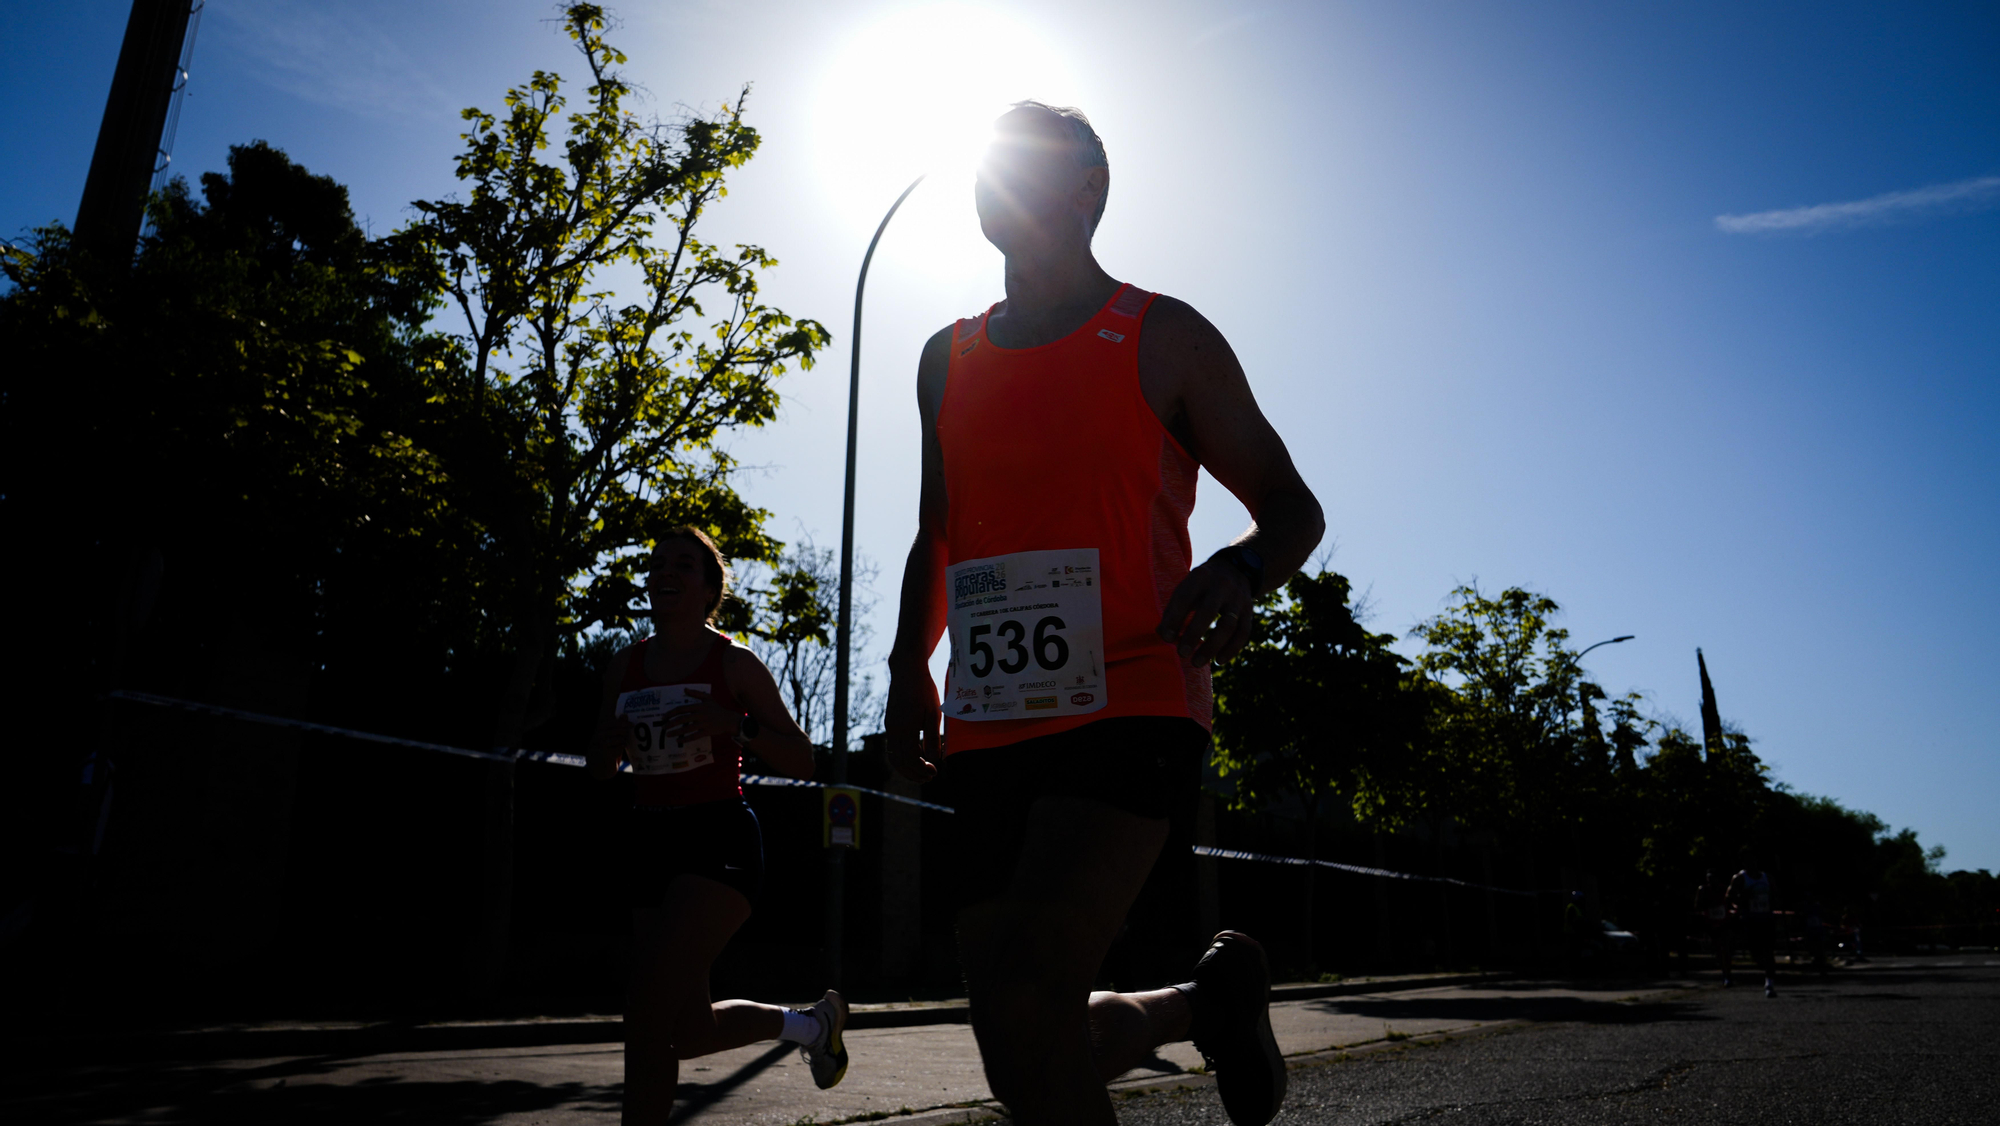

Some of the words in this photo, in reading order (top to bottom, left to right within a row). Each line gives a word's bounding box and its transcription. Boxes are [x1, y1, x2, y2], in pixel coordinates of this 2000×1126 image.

[955, 579, 1006, 602] populares
[969, 615, 1069, 678] 536
[1026, 680, 1057, 689] IMDECO
